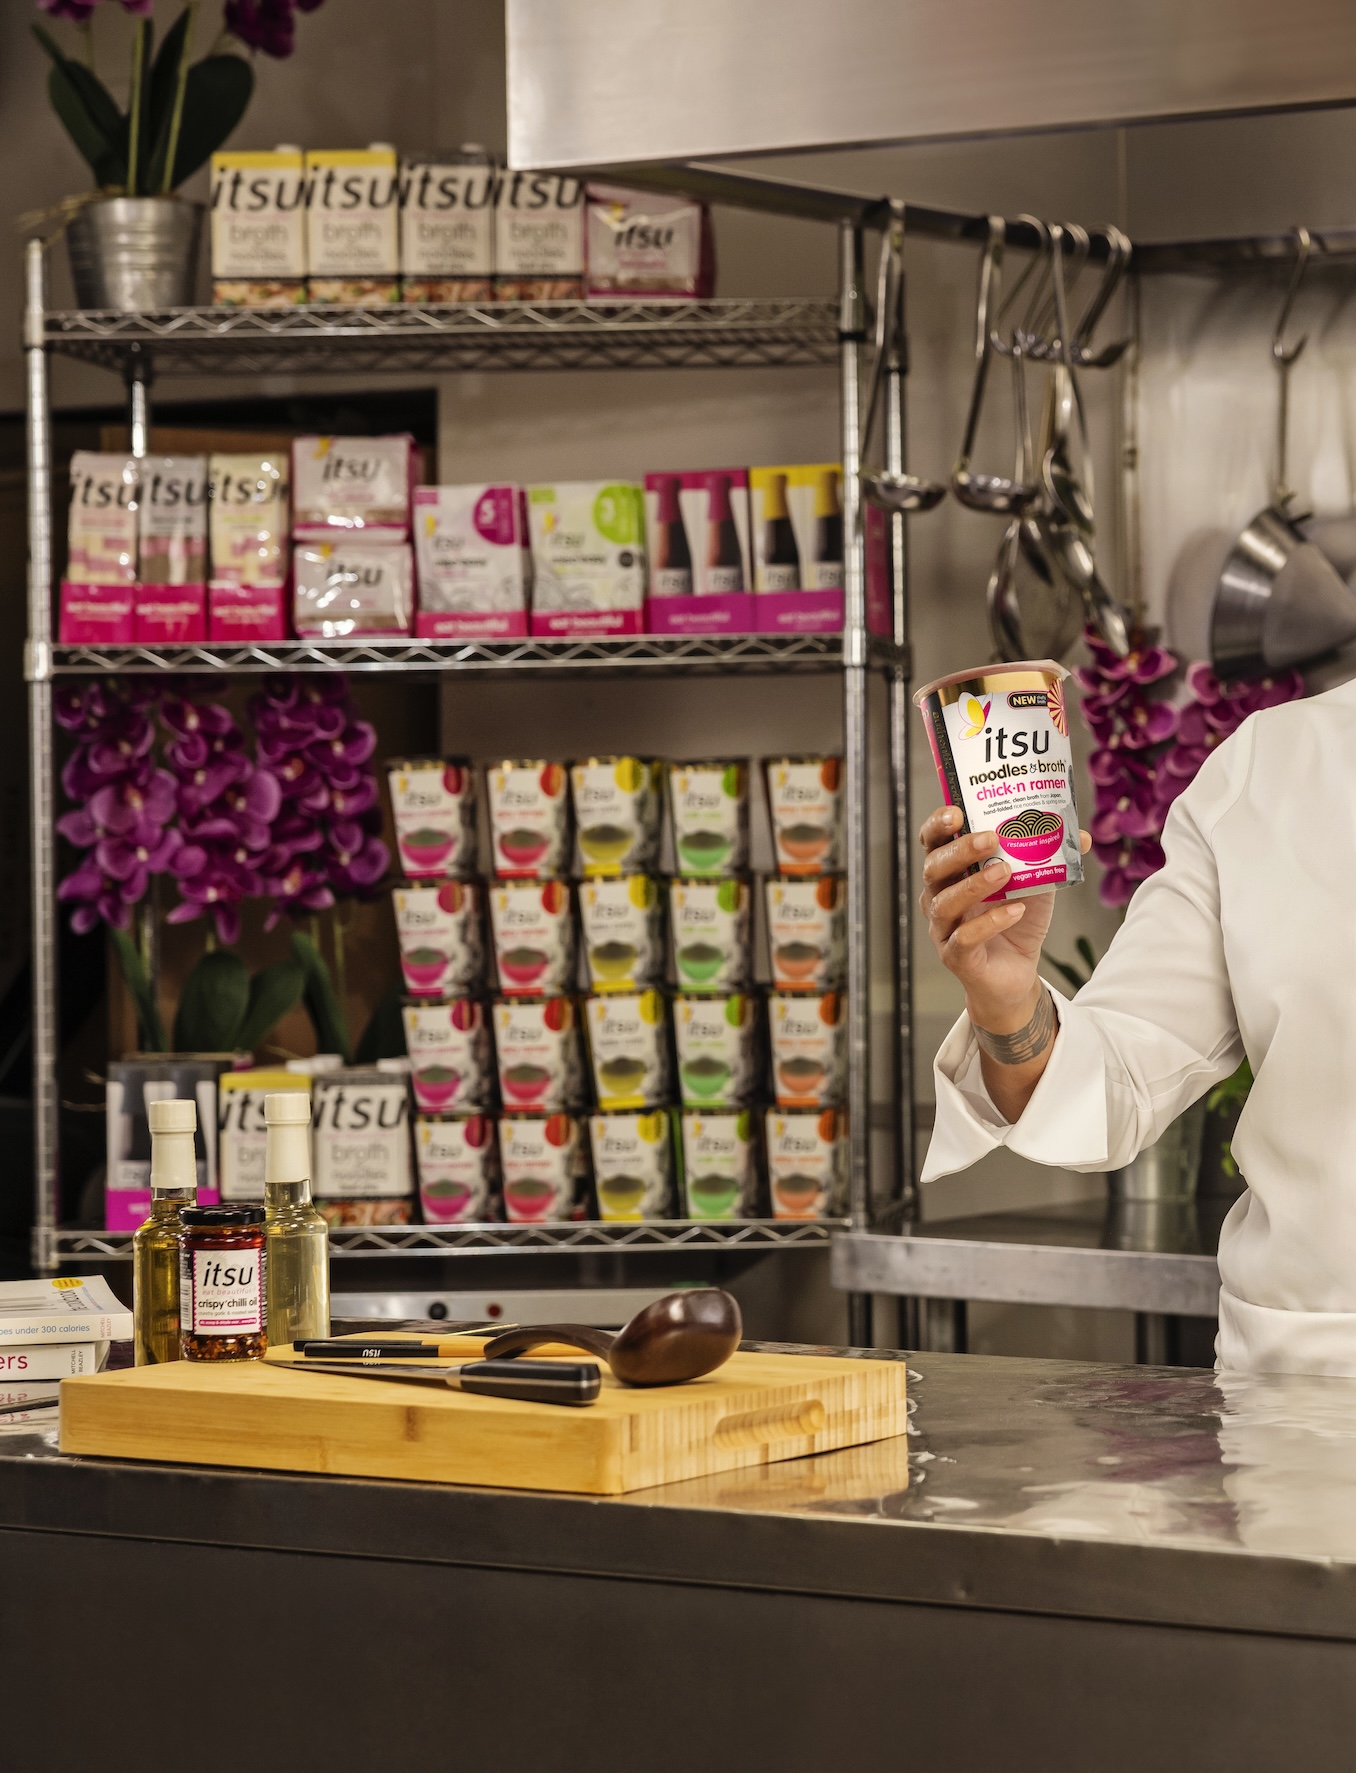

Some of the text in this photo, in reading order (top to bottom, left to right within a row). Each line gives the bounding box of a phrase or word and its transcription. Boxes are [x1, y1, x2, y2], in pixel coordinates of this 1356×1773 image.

[211, 165, 304, 211] itsu
[305, 164, 398, 210] itsu
[399, 163, 491, 210] itsu
[493, 172, 581, 210] itsu
[323, 453, 380, 482] itsu
[1012, 695, 1037, 706] NEW
[985, 727, 1049, 763] itsu
[969, 763, 1028, 786] noodles
[1038, 759, 1066, 773] broth
[1030, 779, 1066, 791] ramen
[1006, 832, 1061, 848] restaurant inspired
[1012, 872, 1032, 882] vegan
[1054, 866, 1065, 874] free
[313, 1085, 408, 1130] itsu
[203, 1261, 253, 1287] itsu
[227, 1297, 247, 1308] chilli
[249, 1296, 257, 1306] oil
[15, 1327, 39, 1335] under
[41, 1325, 57, 1333] 300
[59, 1324, 90, 1333] calories
[362, 1348, 381, 1358] itsu
